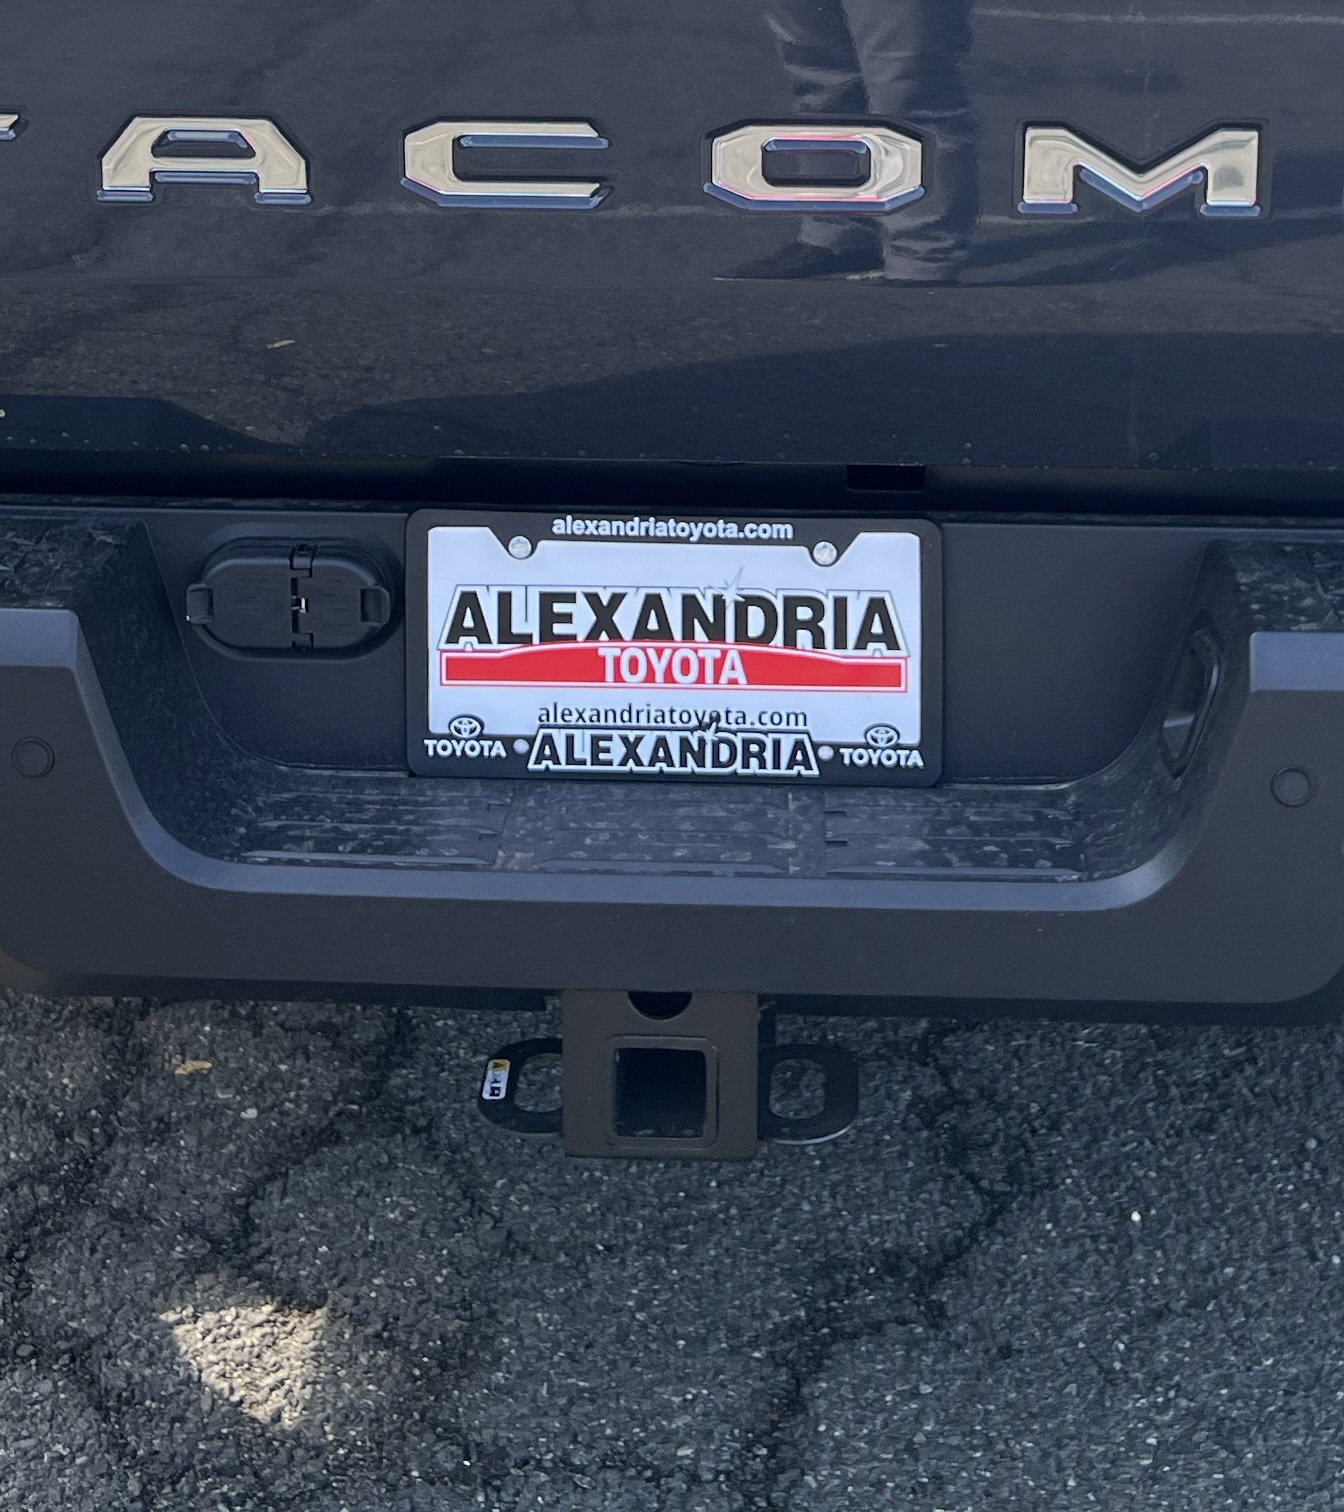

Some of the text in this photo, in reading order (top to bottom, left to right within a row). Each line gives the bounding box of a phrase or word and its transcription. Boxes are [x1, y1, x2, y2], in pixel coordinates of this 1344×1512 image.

[552, 515, 794, 542] alexandriatoyota.com
[442, 587, 904, 653] ALEXANDRIA
[598, 647, 748, 686] TOYOTA
[537, 703, 809, 729] alexandriatoyota.com
[424, 738, 507, 760] TOYOTA
[529, 730, 819, 776] ALEXANDRIA
[840, 746, 925, 769] TOYOTA
